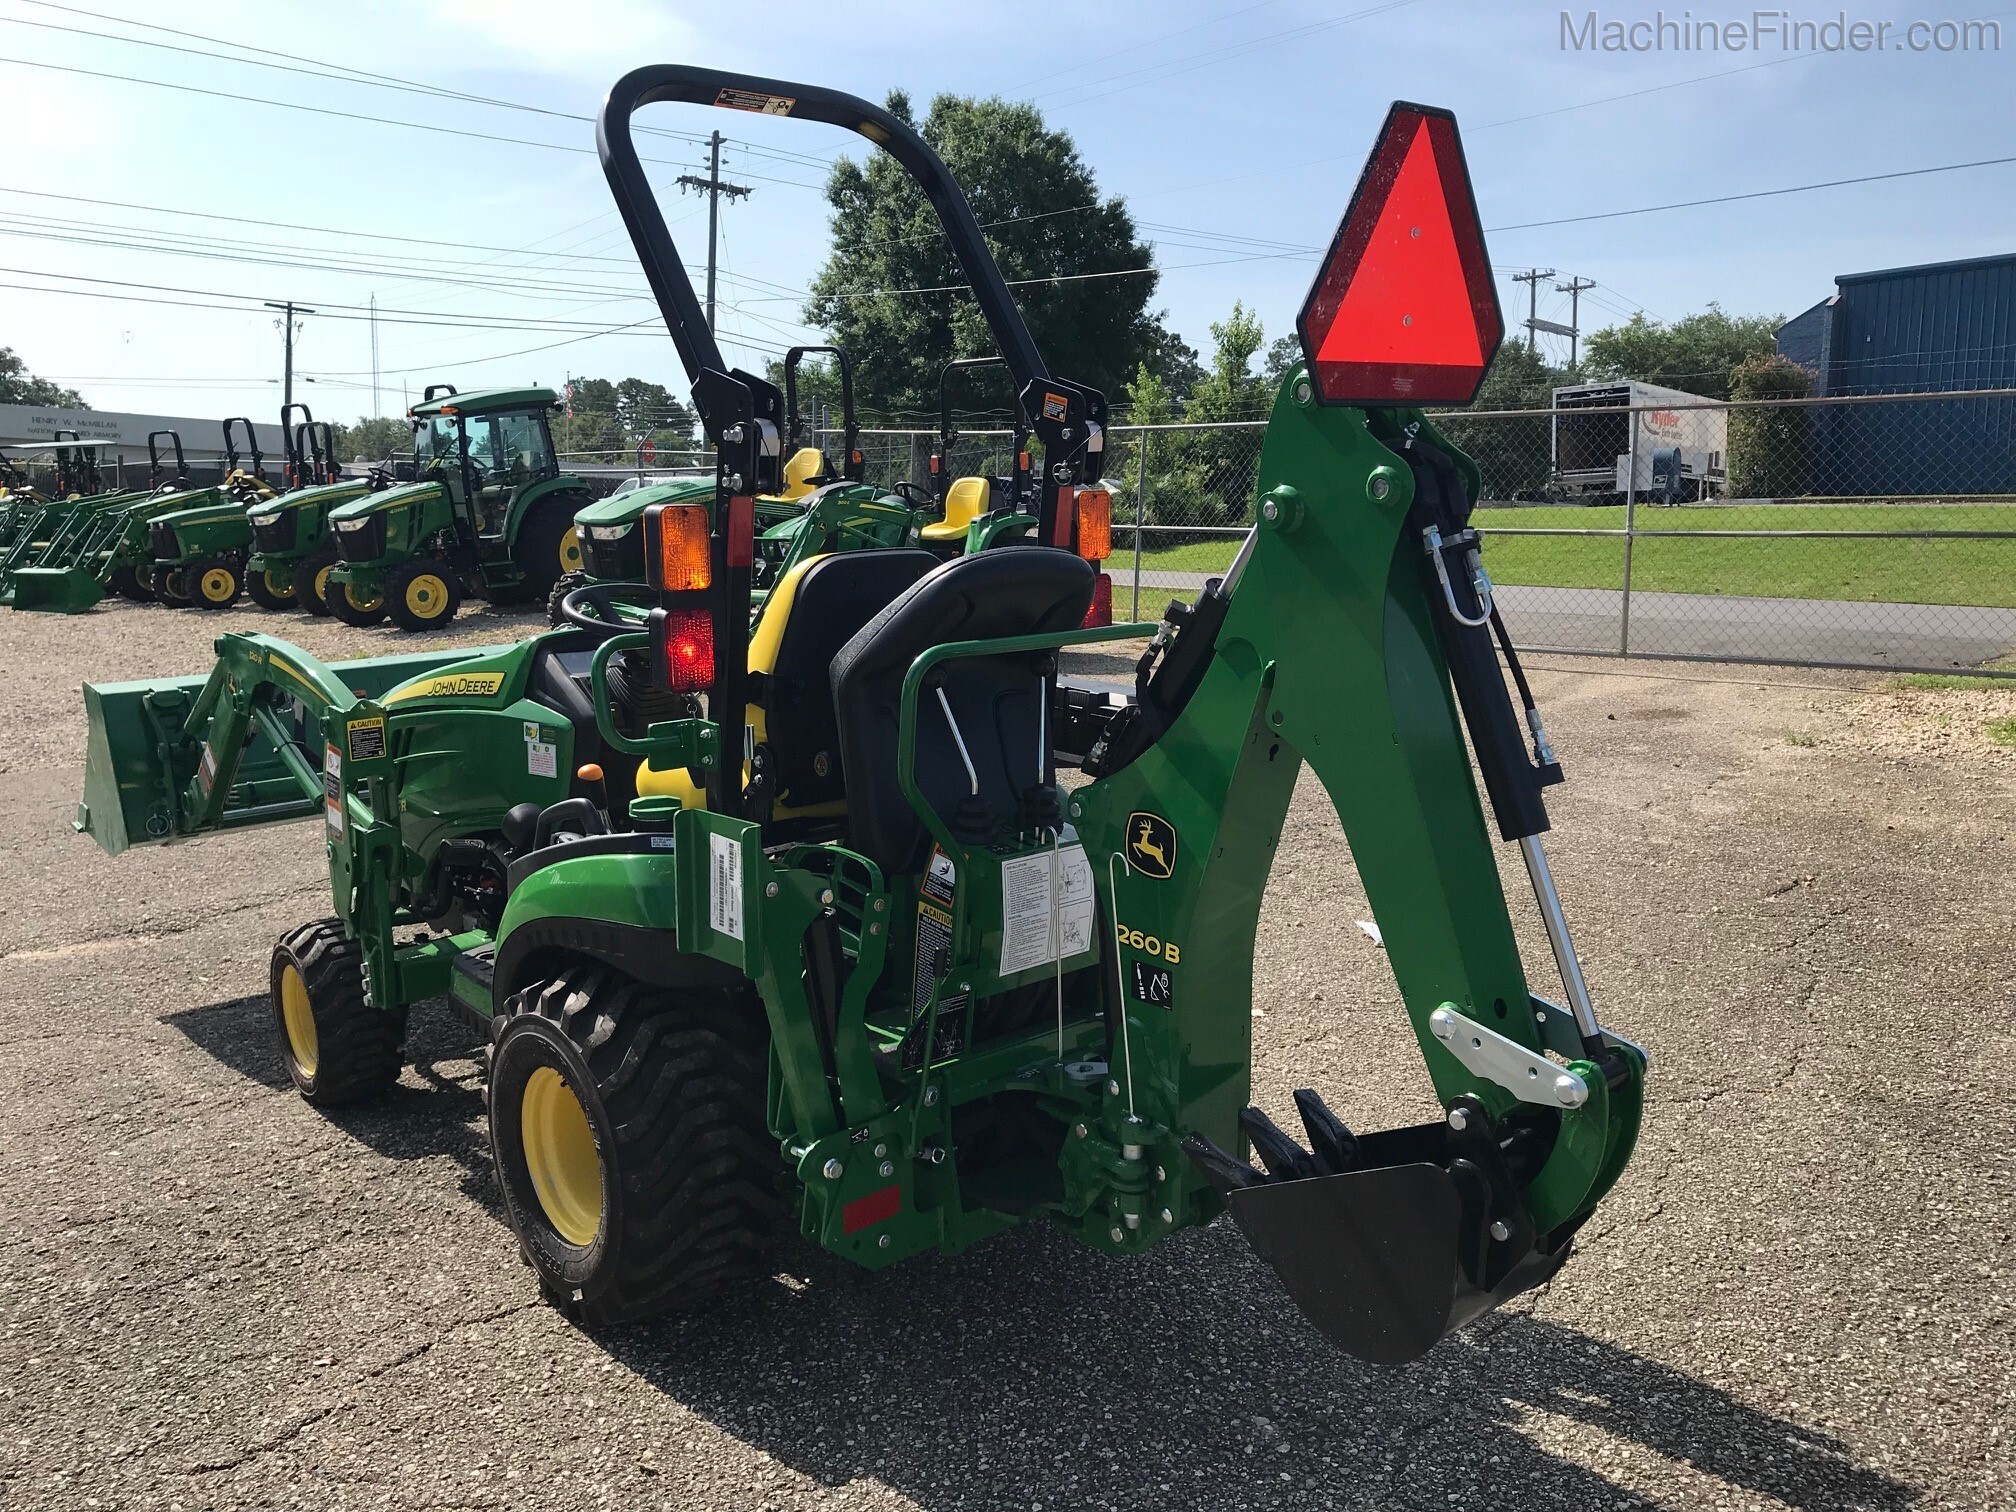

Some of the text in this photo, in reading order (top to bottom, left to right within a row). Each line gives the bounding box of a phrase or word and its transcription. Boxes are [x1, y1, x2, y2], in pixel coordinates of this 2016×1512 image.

[31, 416, 57, 425] HENRY
[93, 431, 122, 439] ARMORY
[427, 678, 495, 695] JOHN DEERE
[357, 718, 382, 728] CAUTION
[928, 907, 952, 926] CAUTION
[1117, 923, 1161, 956] 260
[1164, 941, 1181, 965] B
